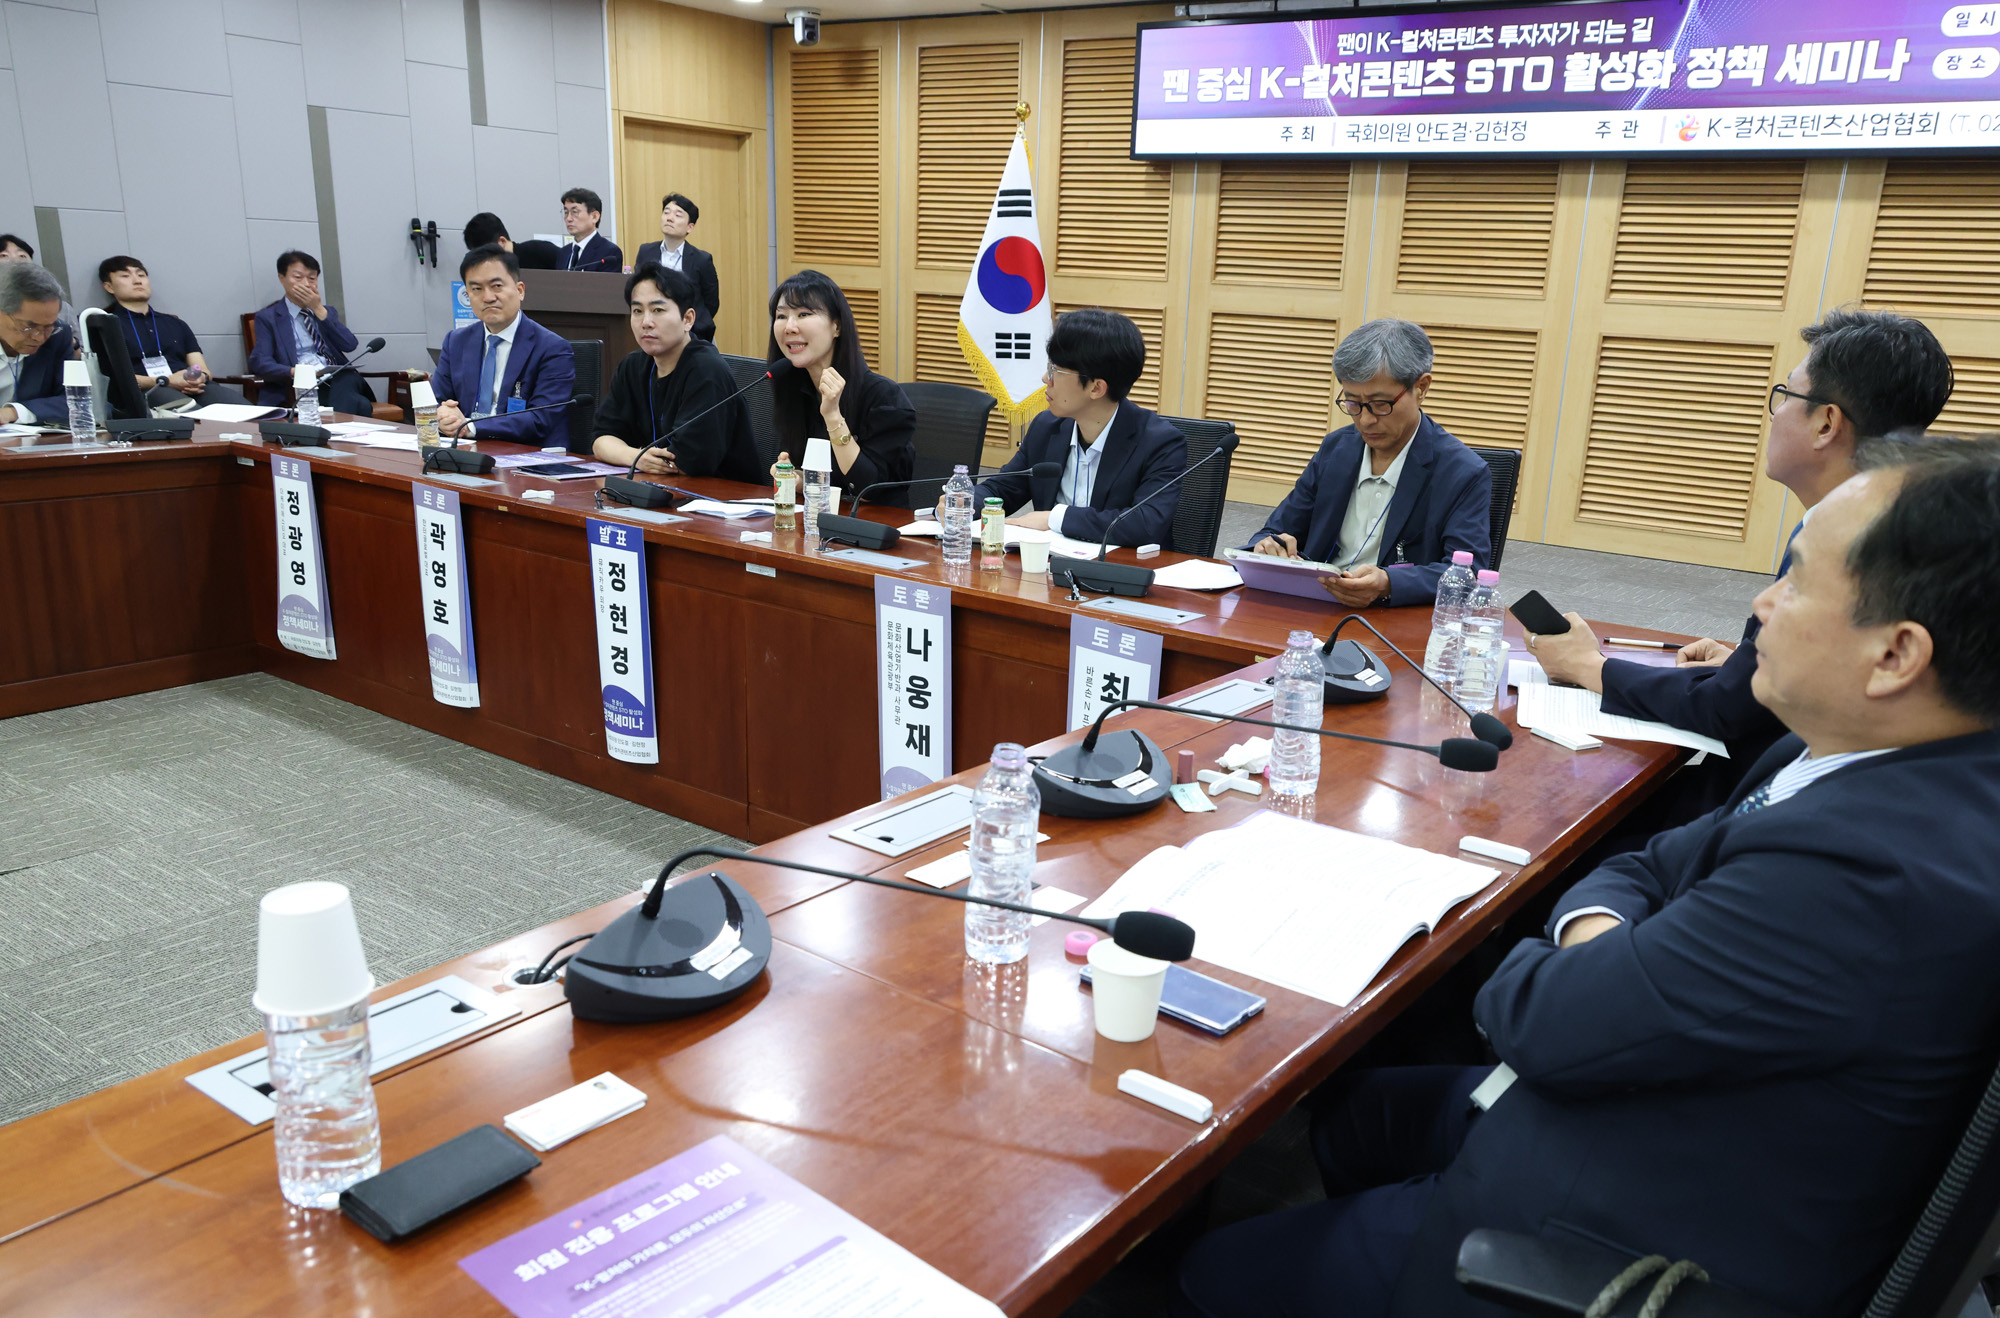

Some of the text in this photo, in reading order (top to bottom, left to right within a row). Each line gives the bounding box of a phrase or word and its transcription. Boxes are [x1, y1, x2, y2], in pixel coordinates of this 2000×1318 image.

[1337, 17, 1655, 56] 팬이 K-컬처콘텐츠 투자자가 되는 길
[1162, 37, 1912, 103] 팬 중심 K-컬처콘텐츠 STO 활성화 정책 세미나
[1345, 122, 1412, 144] 국회의원
[1706, 111, 1941, 140] K-컬처콘텐츠산업협회
[513, 1248, 570, 1282] 회원
[563, 1226, 615, 1256] 전용
[612, 1182, 701, 1233] 프로그램
[694, 1161, 742, 1190] 안내
